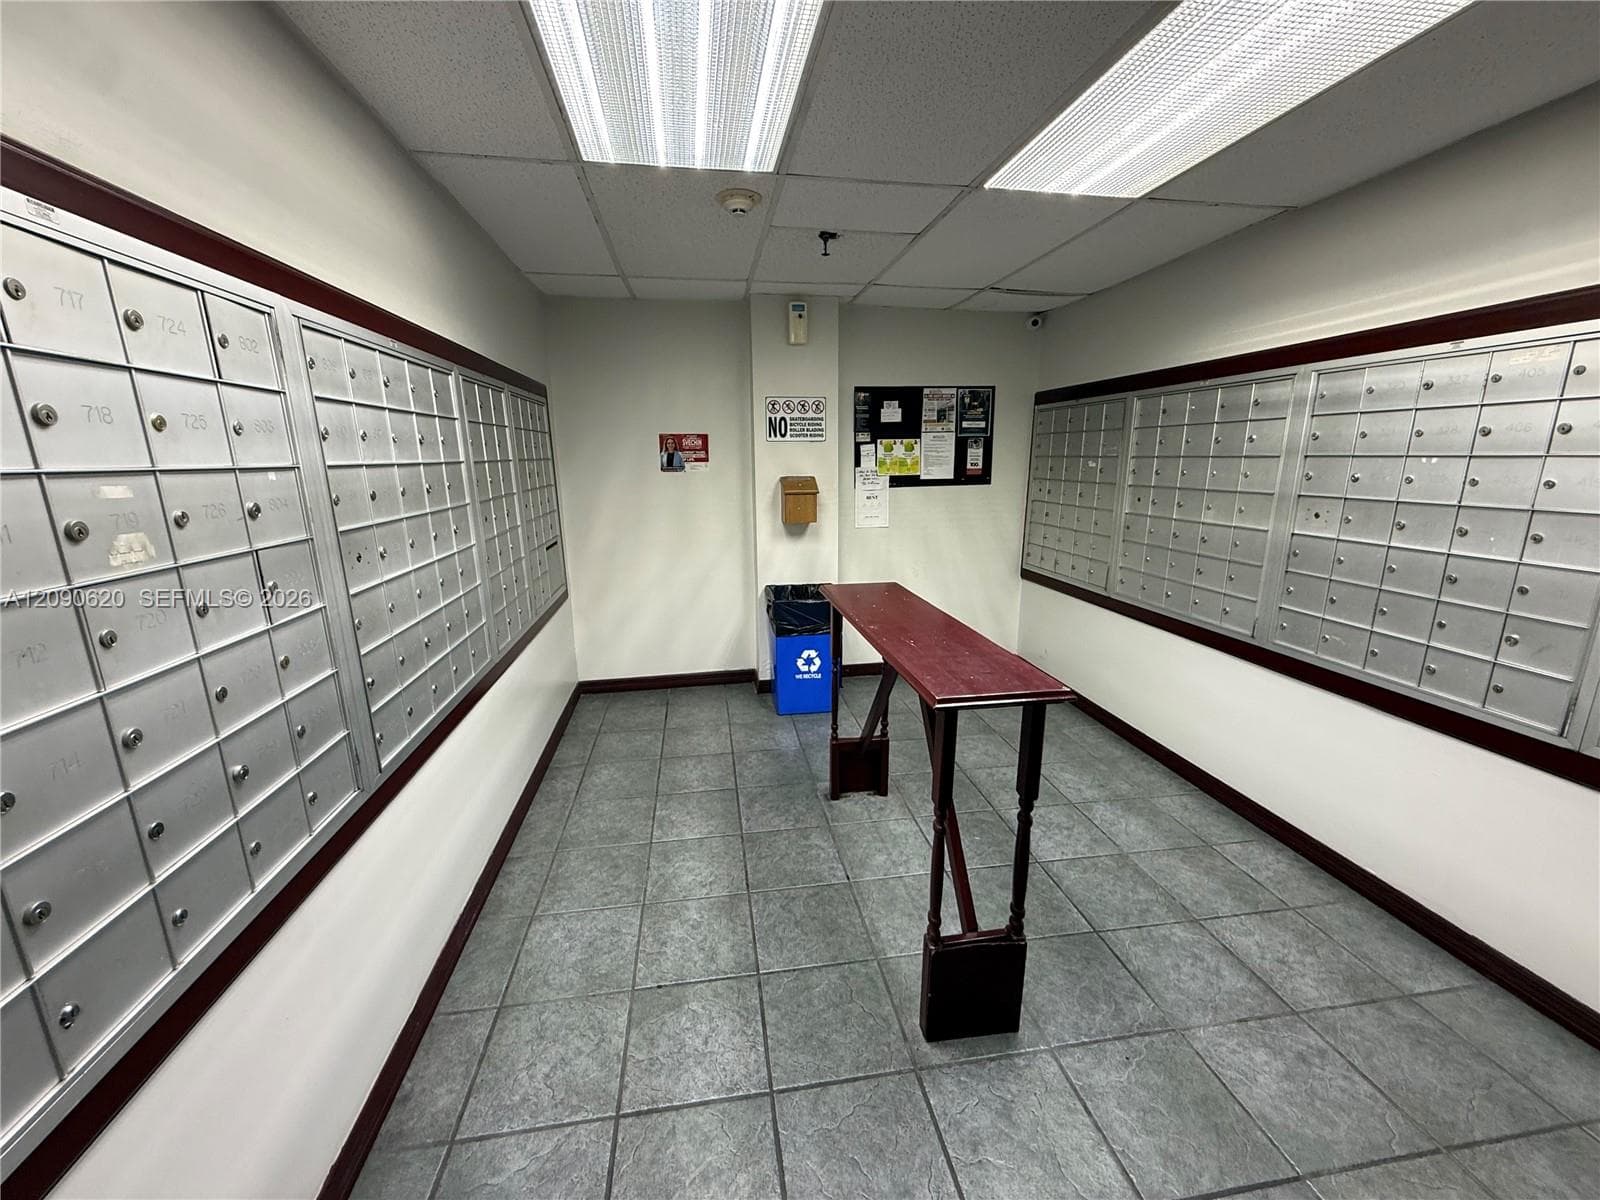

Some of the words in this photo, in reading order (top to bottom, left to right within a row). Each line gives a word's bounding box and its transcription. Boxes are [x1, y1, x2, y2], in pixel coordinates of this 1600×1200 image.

[53, 286, 84, 311] 717
[157, 315, 187, 337] 724
[81, 404, 114, 425] 718
[768, 416, 788, 438] NO
[1504, 422, 1533, 433] 406
[109, 511, 140, 531] 719
[202, 502, 227, 520] 726
